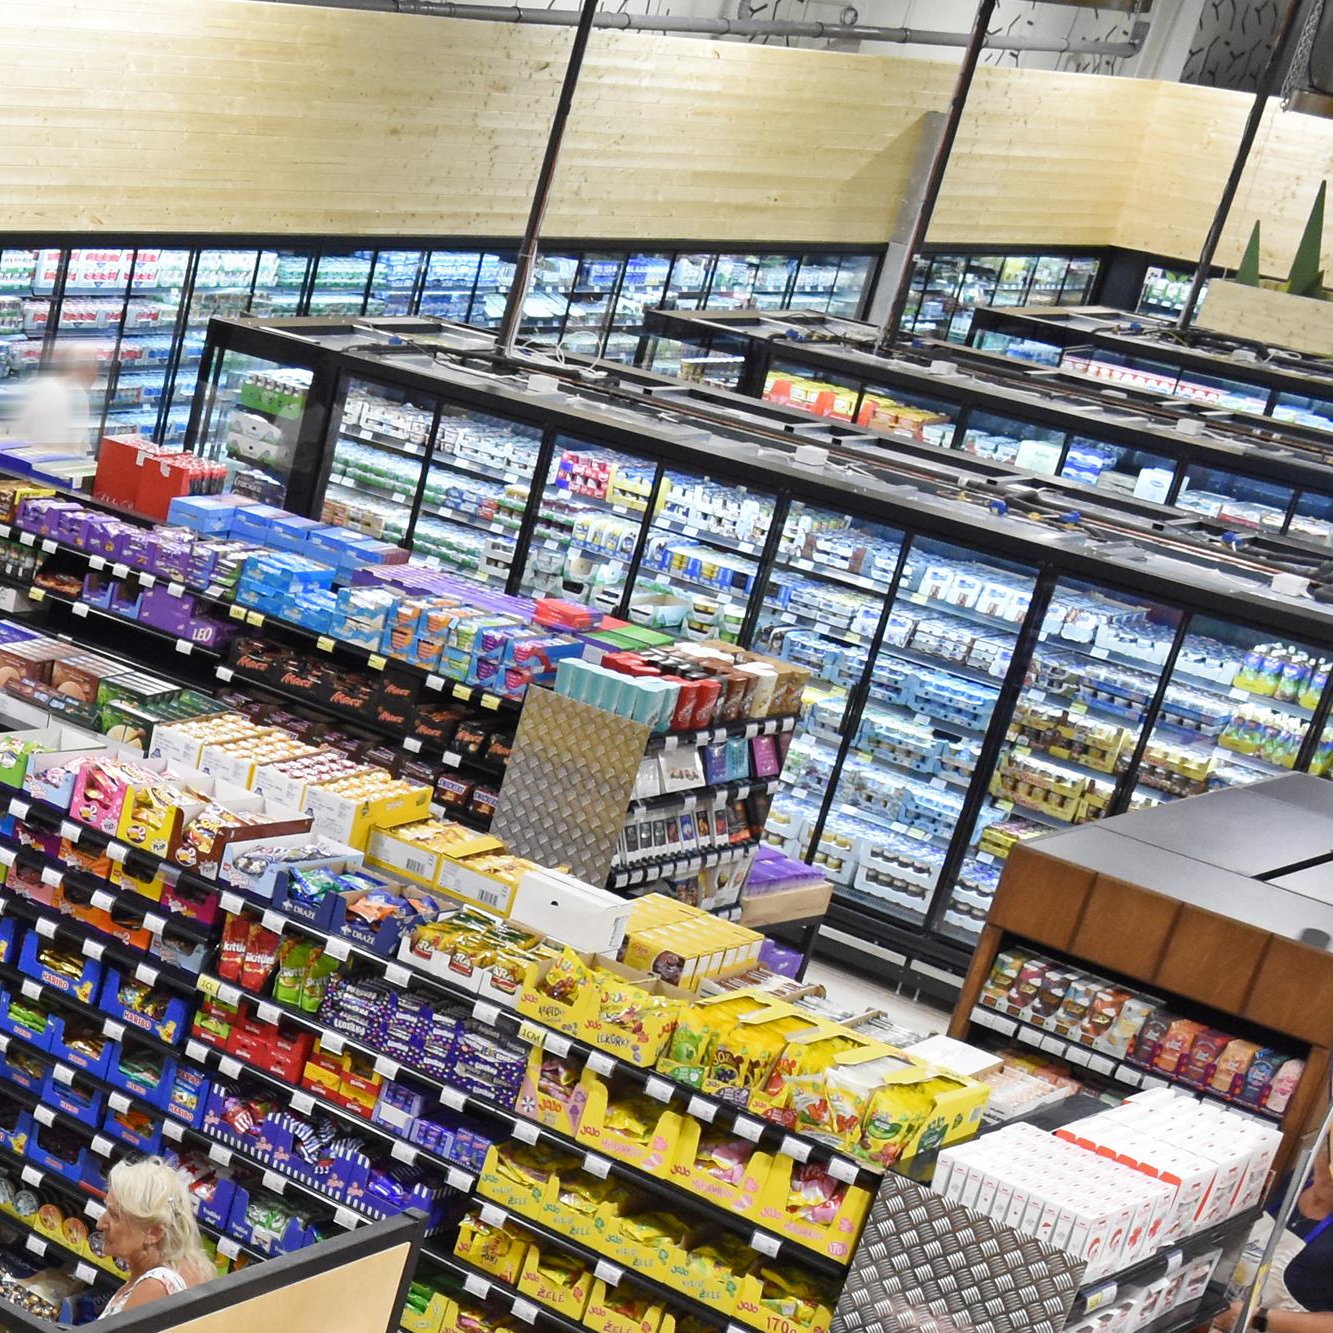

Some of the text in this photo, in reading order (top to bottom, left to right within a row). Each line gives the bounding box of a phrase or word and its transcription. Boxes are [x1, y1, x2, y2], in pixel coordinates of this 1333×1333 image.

[191, 626, 213, 642] LEO
[41, 971, 69, 991] HARIBO
[122, 1010, 151, 1031] HARIBO
[168, 1102, 194, 1122] HARIBO
